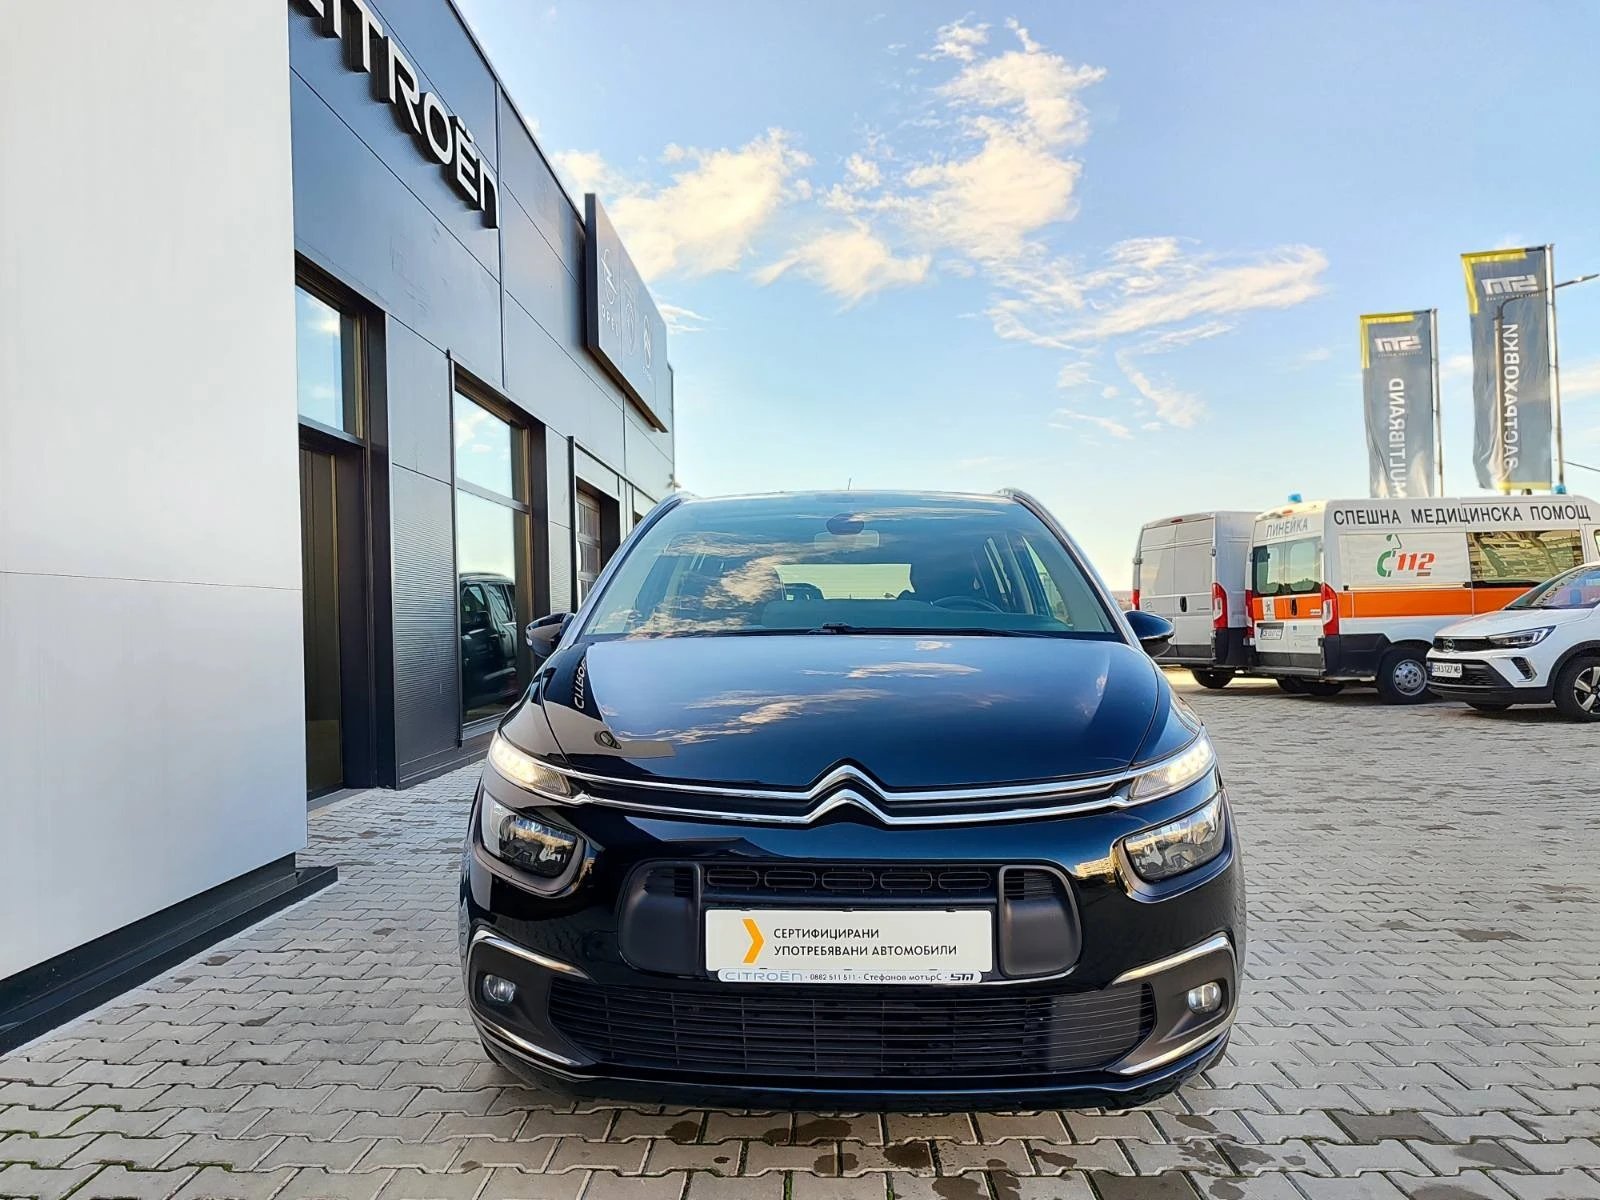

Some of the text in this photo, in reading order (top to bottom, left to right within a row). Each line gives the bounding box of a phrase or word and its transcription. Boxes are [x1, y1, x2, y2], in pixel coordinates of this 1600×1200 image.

[308, 0, 500, 229] ITROËN
[1333, 504, 1591, 525] СПЕШНА МЕДИЦИНСКА ПОМОЩ
[1265, 517, 1308, 539] ЛИНЕЙКА
[1396, 552, 1435, 571] 112
[773, 928, 880, 940] СЕРТИФИЦИРАНИ
[774, 944, 958, 956] УПОТРЕБЯВАНИ АВТОМОБИЛИ
[863, 973, 907, 983] Стефанов
